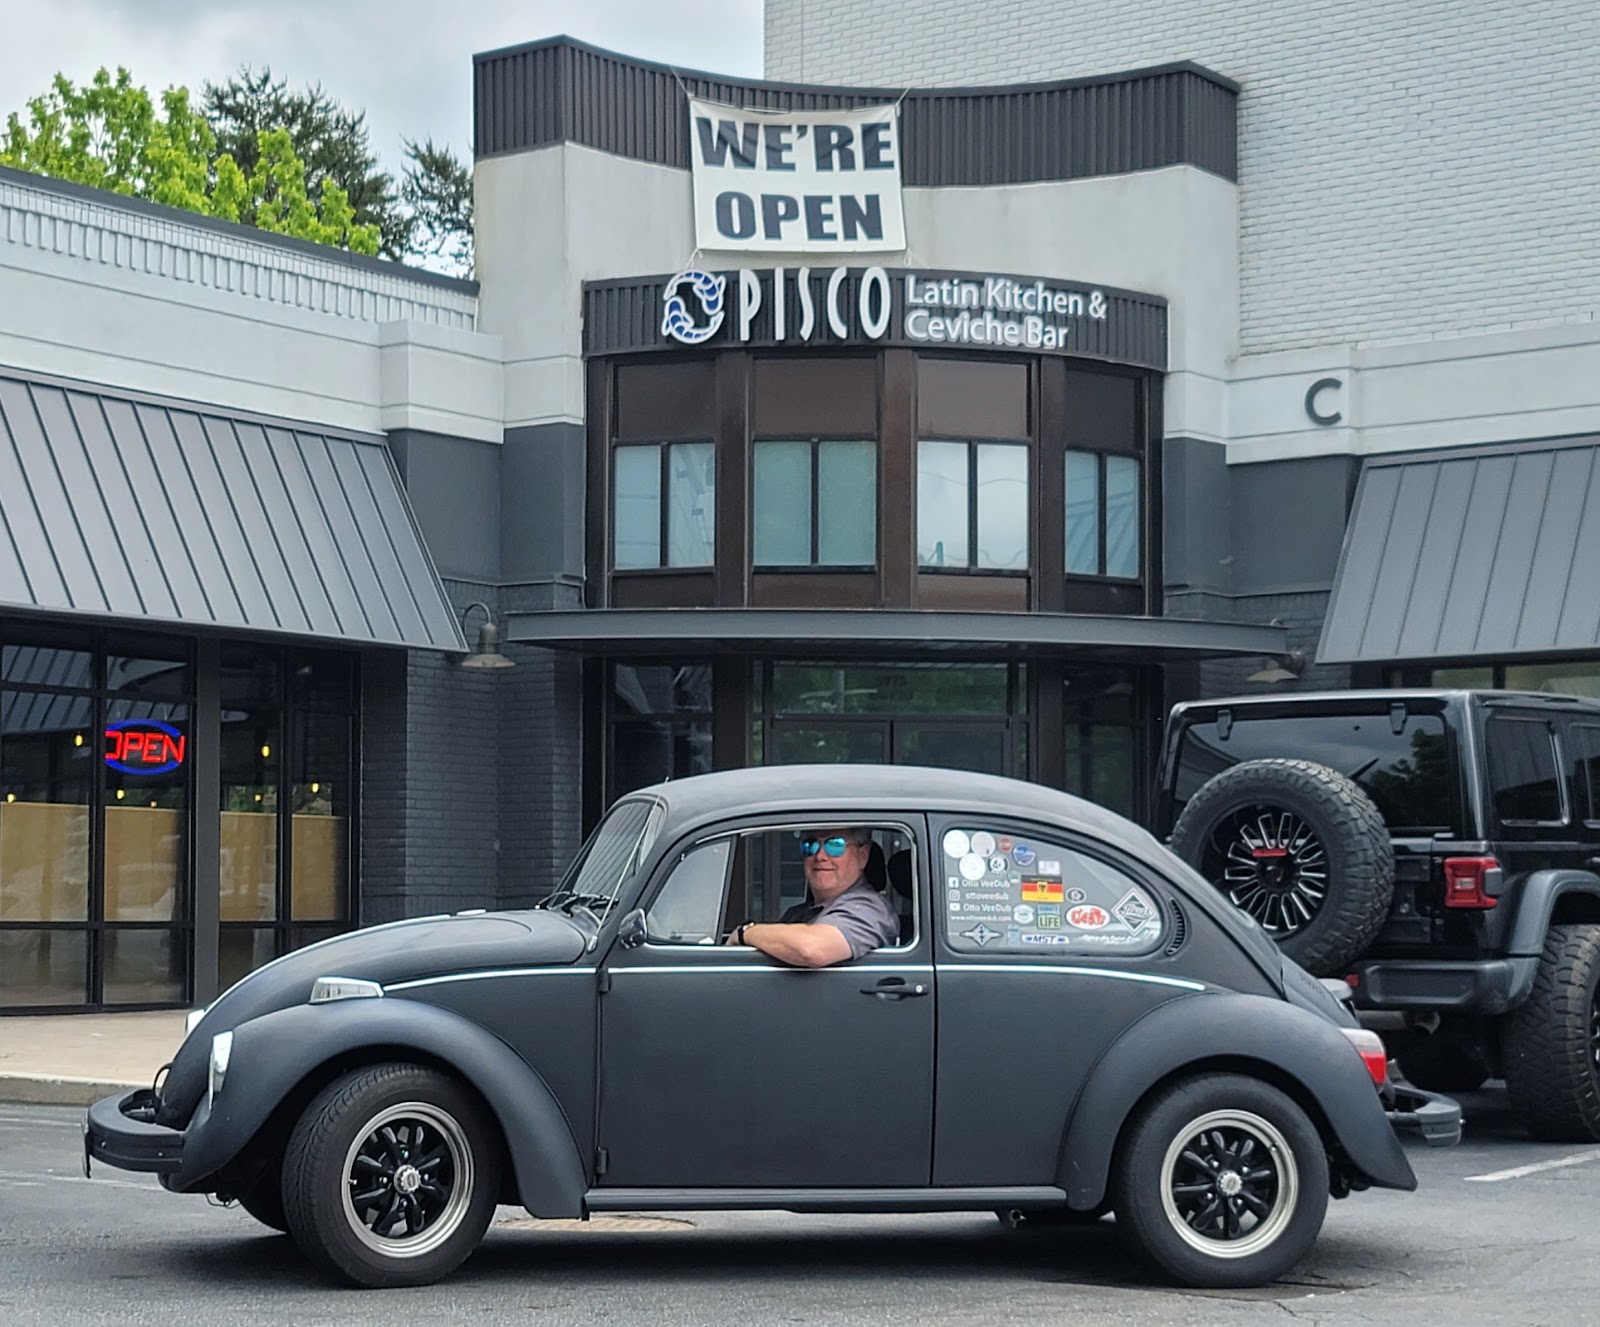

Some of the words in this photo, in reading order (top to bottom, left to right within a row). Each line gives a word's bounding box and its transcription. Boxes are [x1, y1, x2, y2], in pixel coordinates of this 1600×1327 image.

[696, 117, 895, 171] WE'RE
[715, 191, 883, 241] OPEN
[739, 266, 891, 341] PISCO
[905, 274, 979, 307] Latin
[984, 277, 1083, 316] Kitchen
[1088, 290, 1107, 319] &
[905, 309, 1019, 346] Ceviche
[1024, 315, 1068, 349] Bar
[1304, 377, 1342, 426] C
